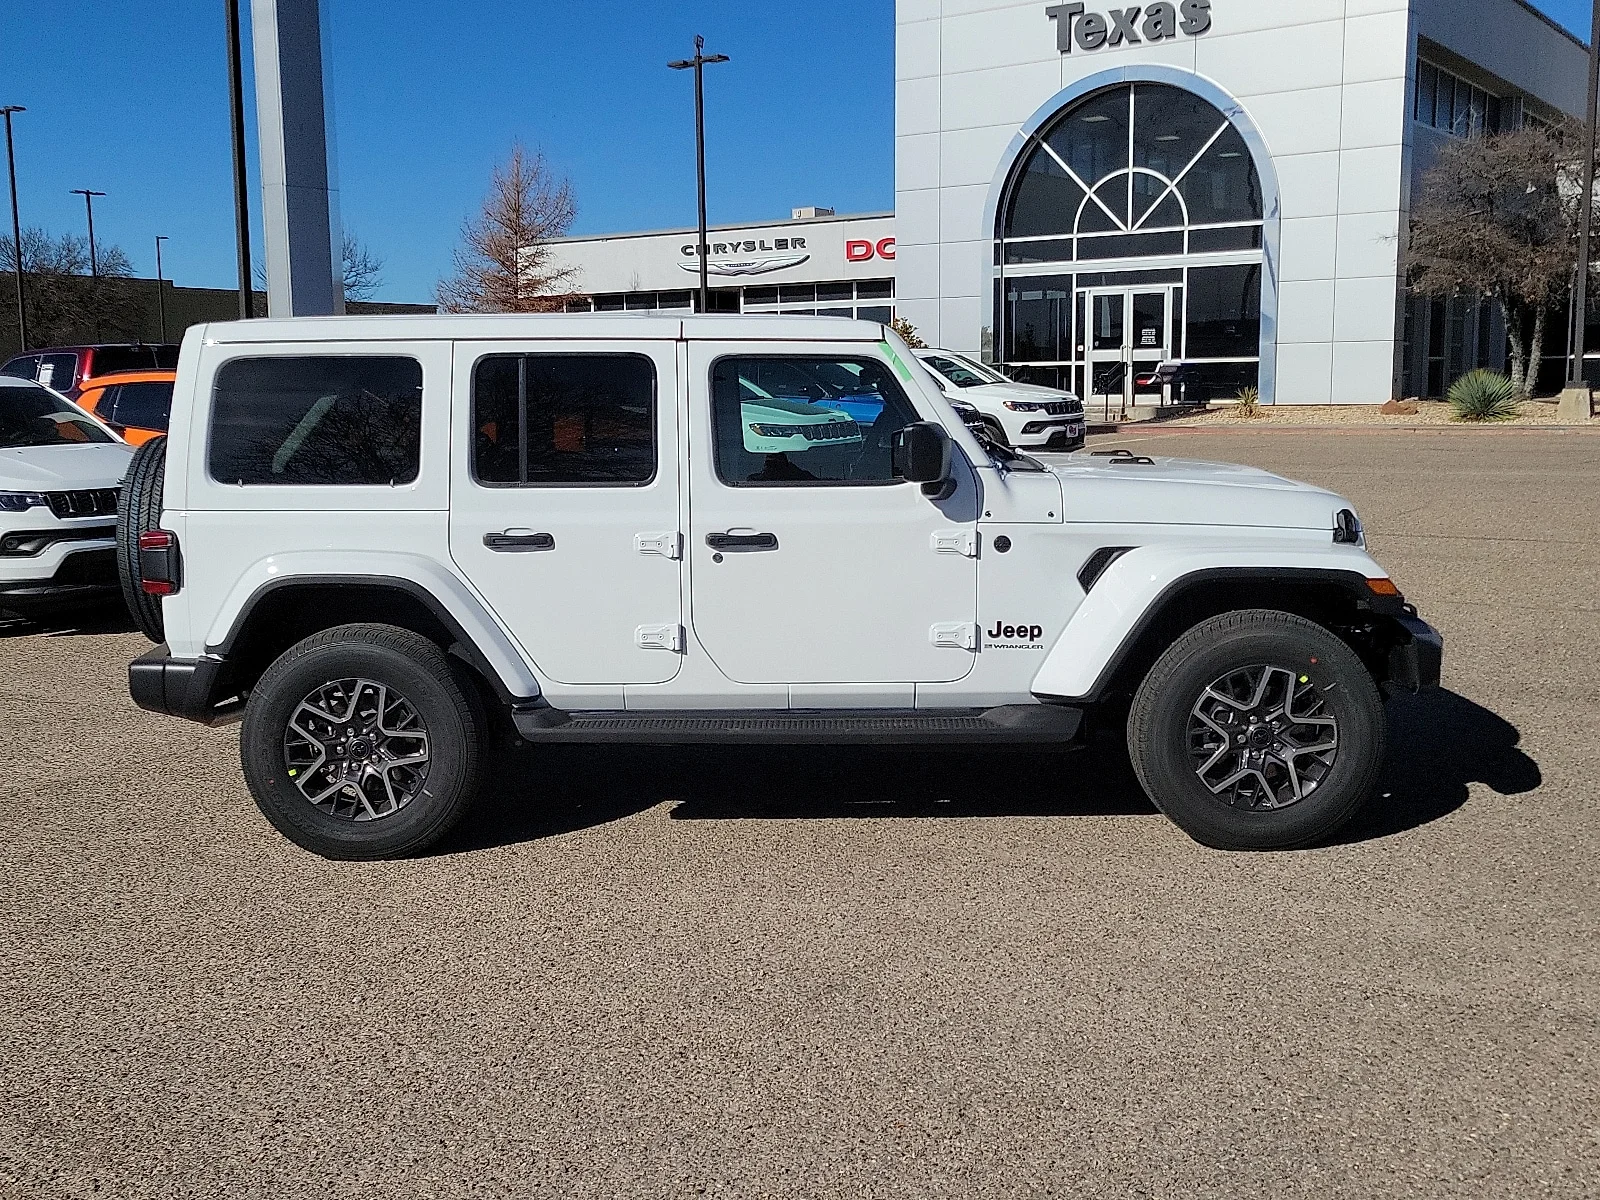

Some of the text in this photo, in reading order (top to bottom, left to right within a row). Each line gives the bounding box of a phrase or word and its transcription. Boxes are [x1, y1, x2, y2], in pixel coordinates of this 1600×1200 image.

[1045, 0, 1212, 53] Texas
[681, 237, 807, 256] CHRYSLER
[987, 620, 1043, 642] Jeep
